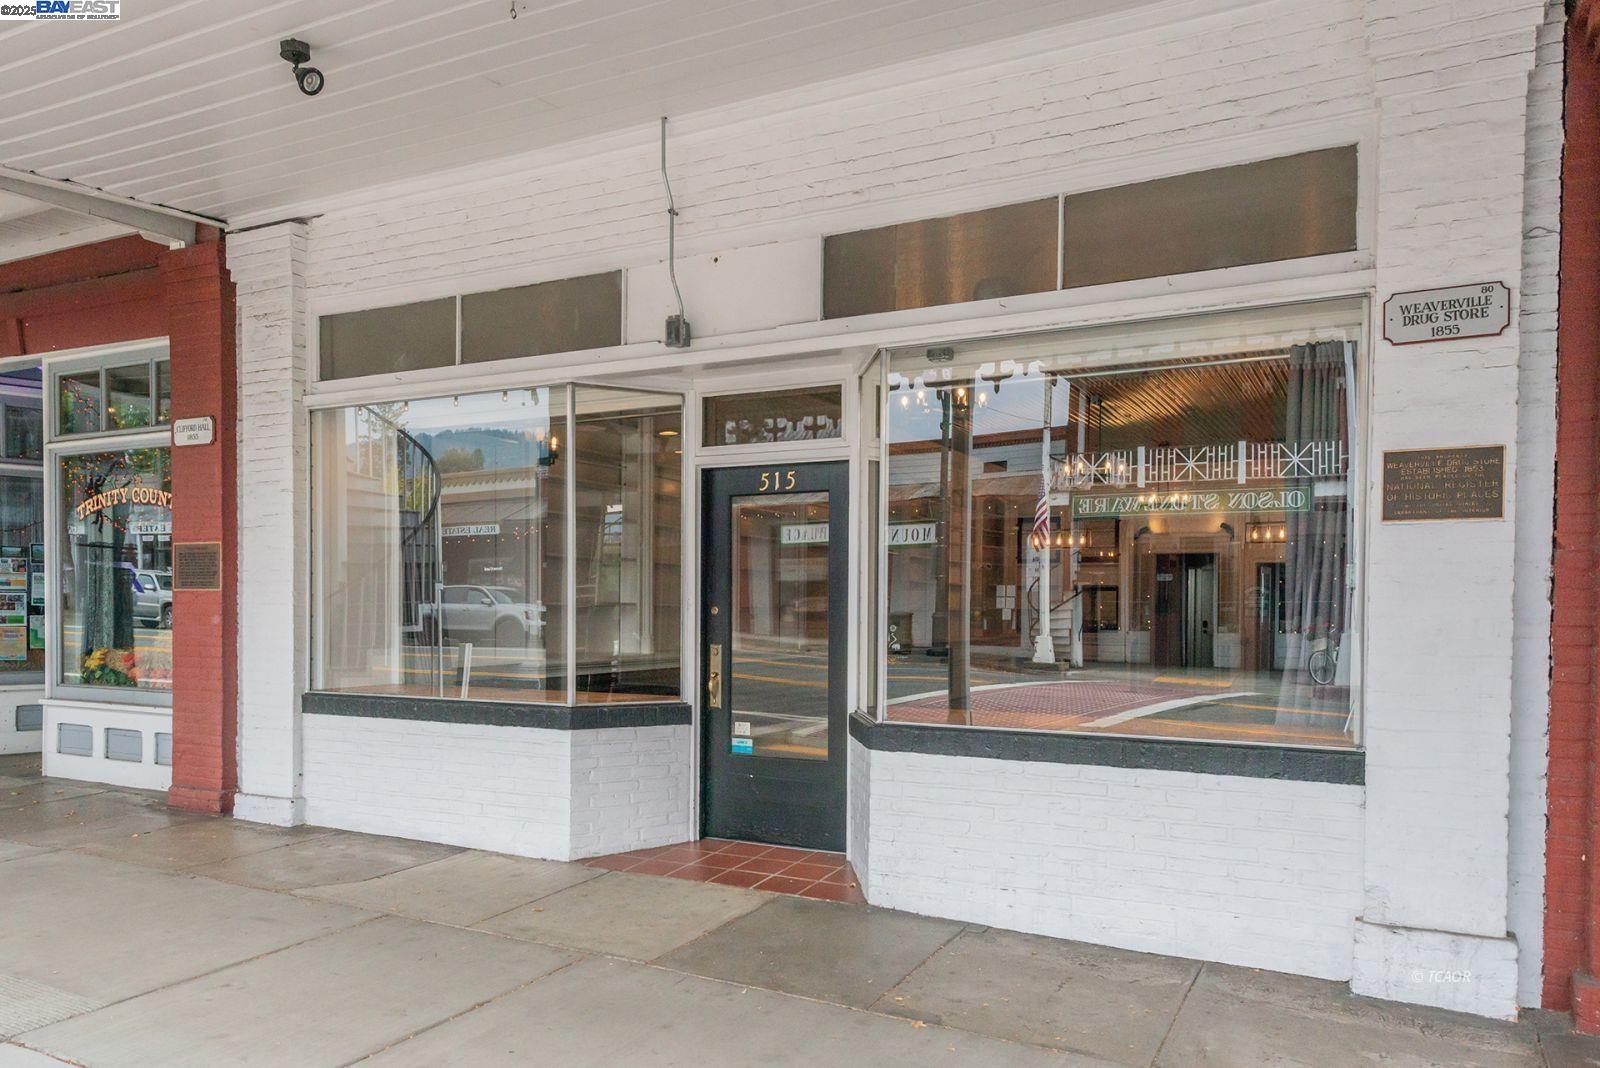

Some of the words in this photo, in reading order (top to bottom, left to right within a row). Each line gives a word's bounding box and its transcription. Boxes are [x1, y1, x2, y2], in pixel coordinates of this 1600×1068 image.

[1481, 285, 1494, 293] 80
[1400, 295, 1493, 315] WEAVERVILLE
[1402, 312, 1439, 327] DRUG
[1443, 307, 1490, 321] STORE
[1431, 325, 1460, 337] 1855
[759, 470, 796, 491] 515
[76, 487, 128, 521] TRINITY
